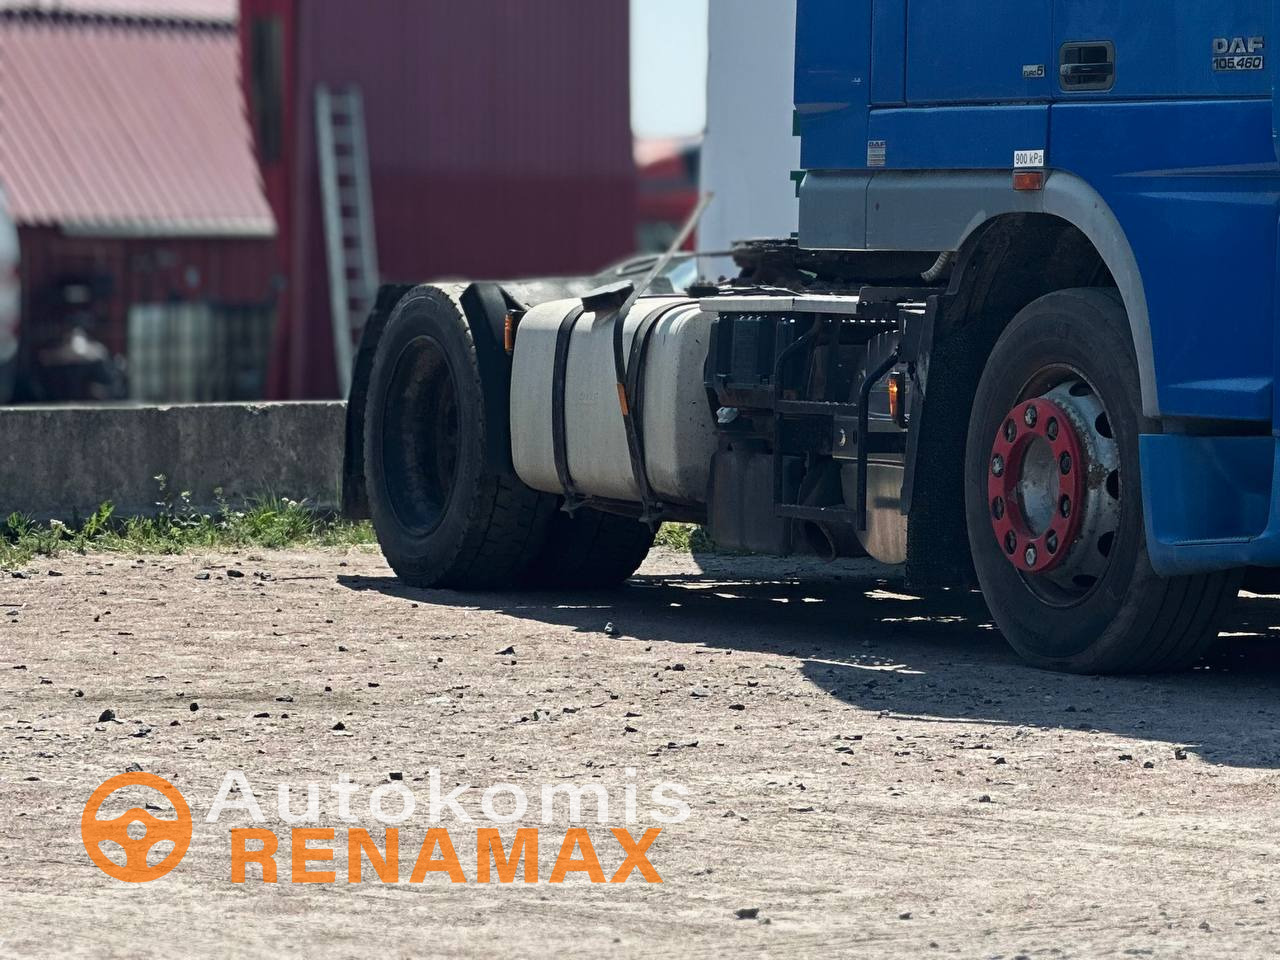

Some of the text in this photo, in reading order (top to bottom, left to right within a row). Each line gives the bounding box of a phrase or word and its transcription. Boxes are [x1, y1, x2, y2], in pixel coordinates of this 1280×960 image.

[1212, 36, 1264, 54] DAF
[1213, 56, 1262, 69] 105.460
[1015, 152, 1043, 165] 900 kPa
